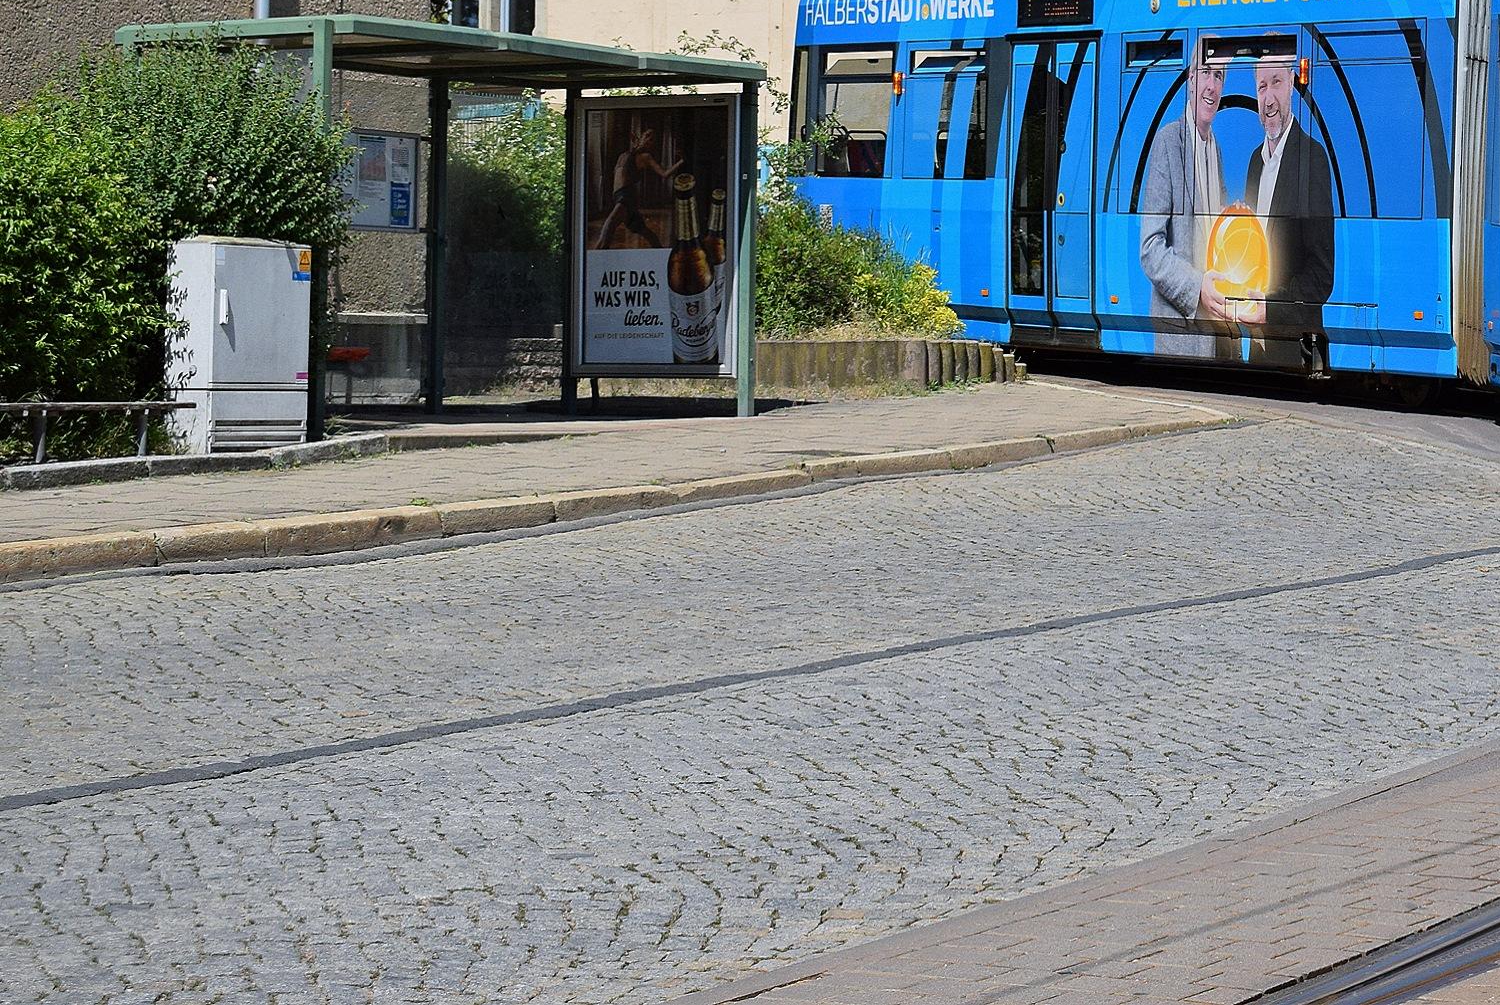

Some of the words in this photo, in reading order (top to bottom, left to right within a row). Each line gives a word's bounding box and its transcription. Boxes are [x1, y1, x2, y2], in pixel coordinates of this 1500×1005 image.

[601, 271, 626, 287] AUF
[630, 271, 659, 290] DAS,
[594, 291, 621, 308] WAS
[624, 291, 651, 307] WIR
[624, 309, 664, 327] lieben.
